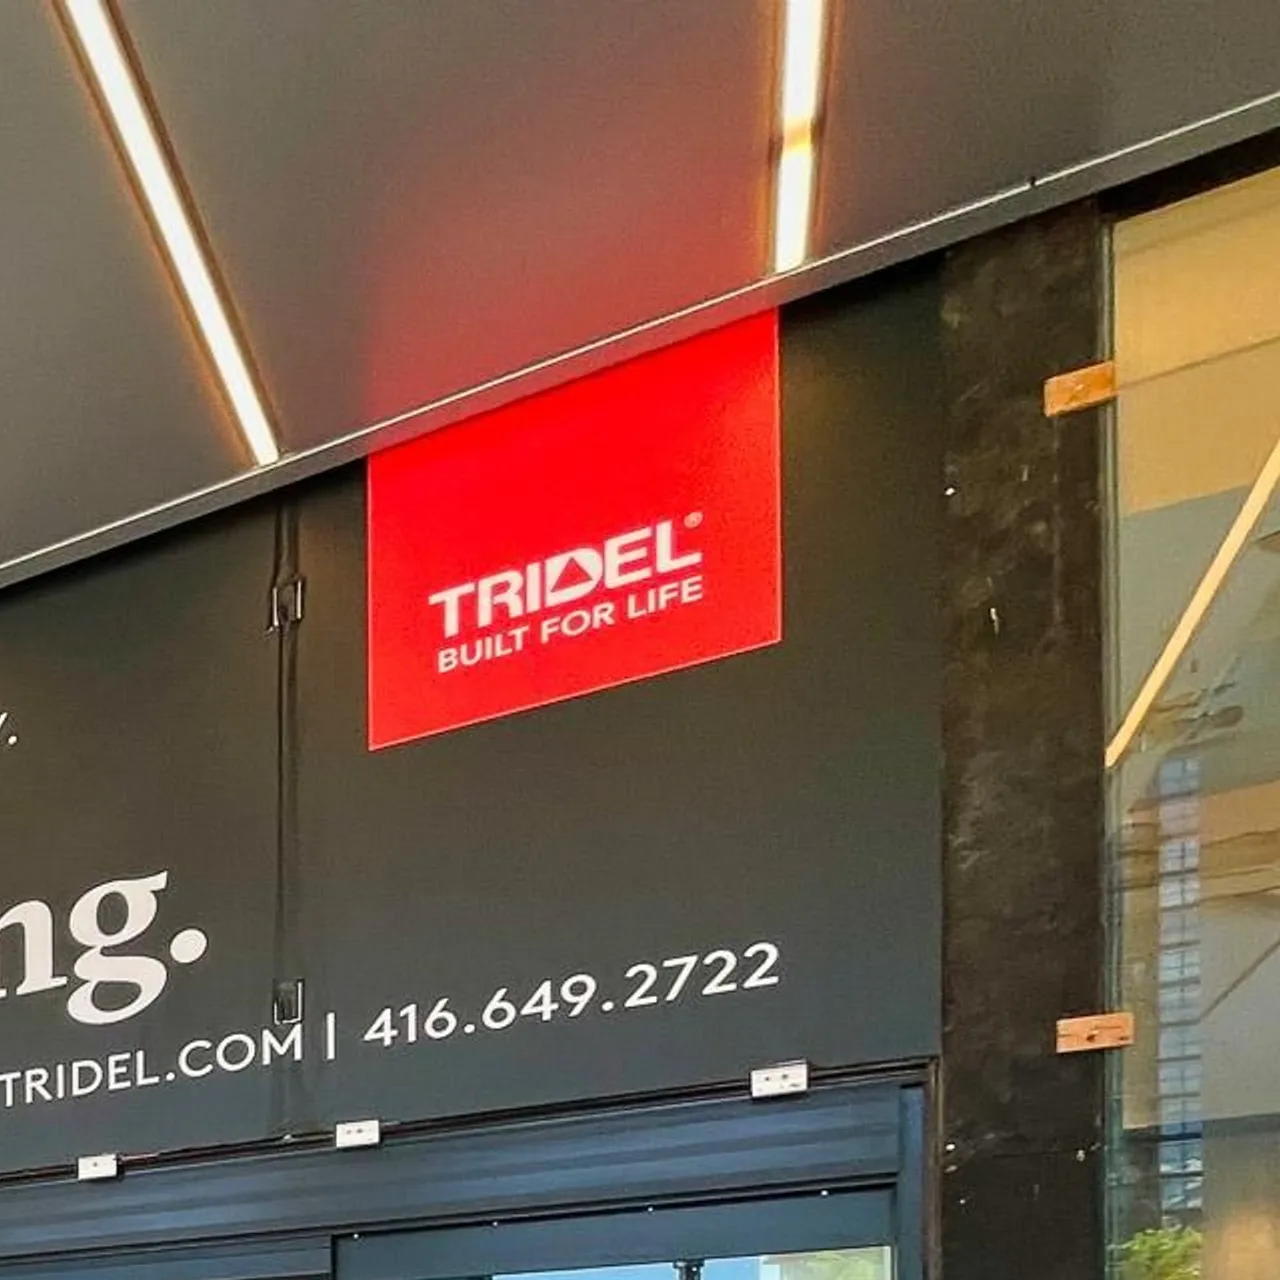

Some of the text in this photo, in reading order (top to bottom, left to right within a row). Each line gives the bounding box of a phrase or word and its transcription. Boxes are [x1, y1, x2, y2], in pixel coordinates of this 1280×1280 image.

[438, 575, 704, 674] BUILT FOR LIFE
[361, 940, 781, 1048] 416.649.2722
